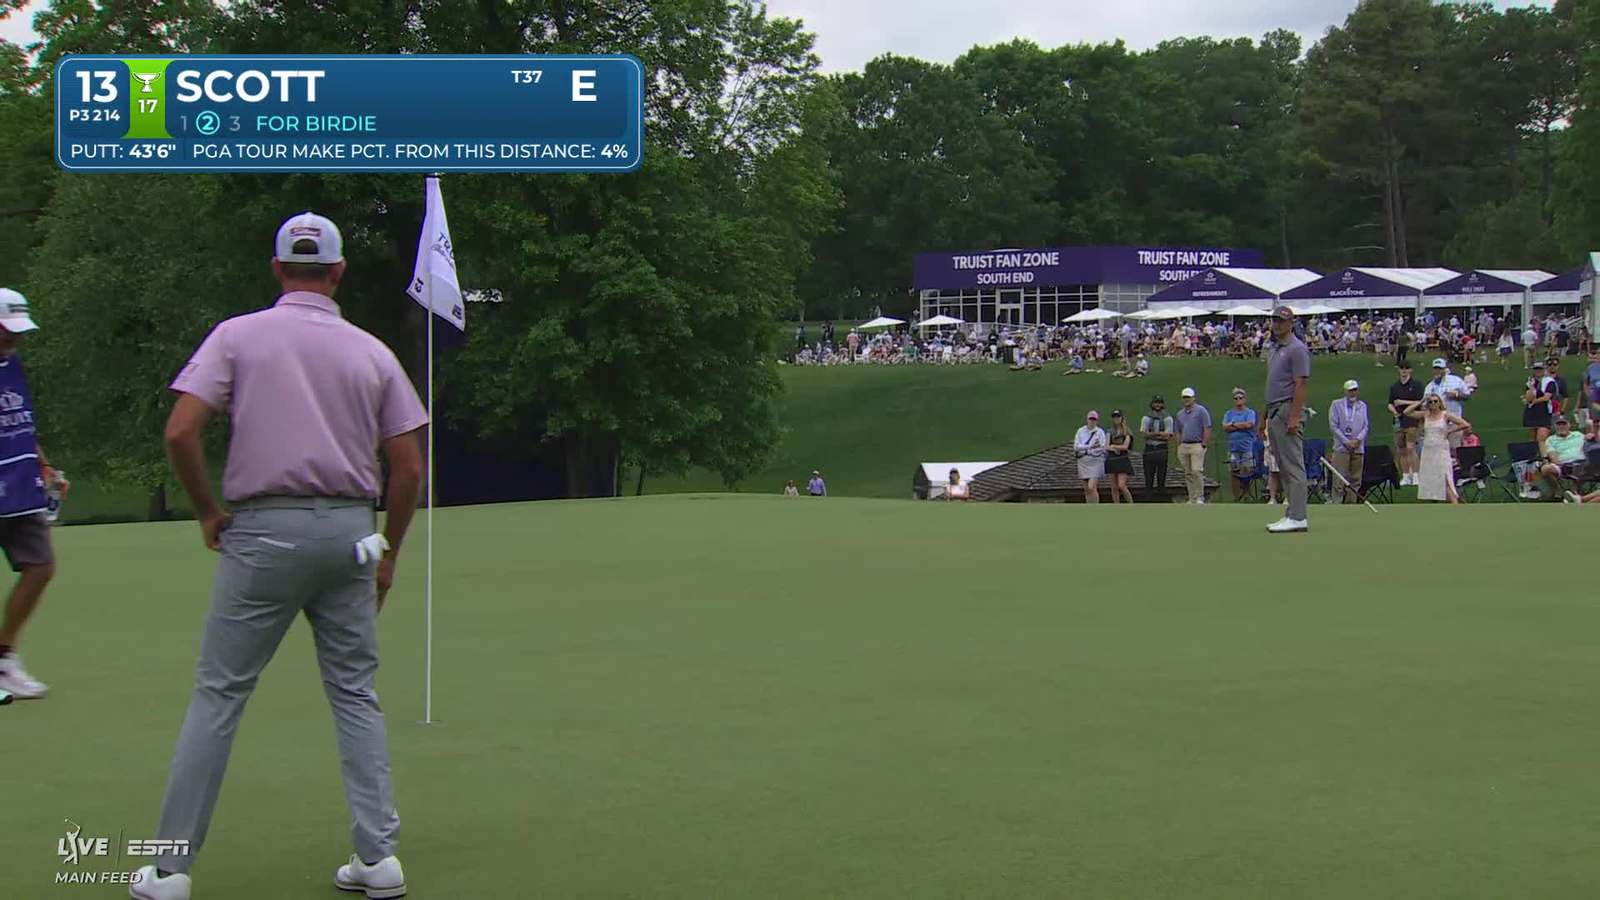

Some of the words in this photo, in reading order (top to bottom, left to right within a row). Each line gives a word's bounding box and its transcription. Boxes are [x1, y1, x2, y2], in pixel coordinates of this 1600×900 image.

[952, 255, 994, 270] TRUIST
[996, 253, 1021, 268] FAN
[1023, 252, 1060, 267] ZONE
[1138, 250, 1175, 265] TRUIST
[1176, 251, 1198, 265] FAN
[1200, 252, 1230, 266] ZONE
[977, 272, 1011, 285] SOUTH
[1013, 271, 1034, 283] END
[1160, 270, 1189, 281] SOUTH
